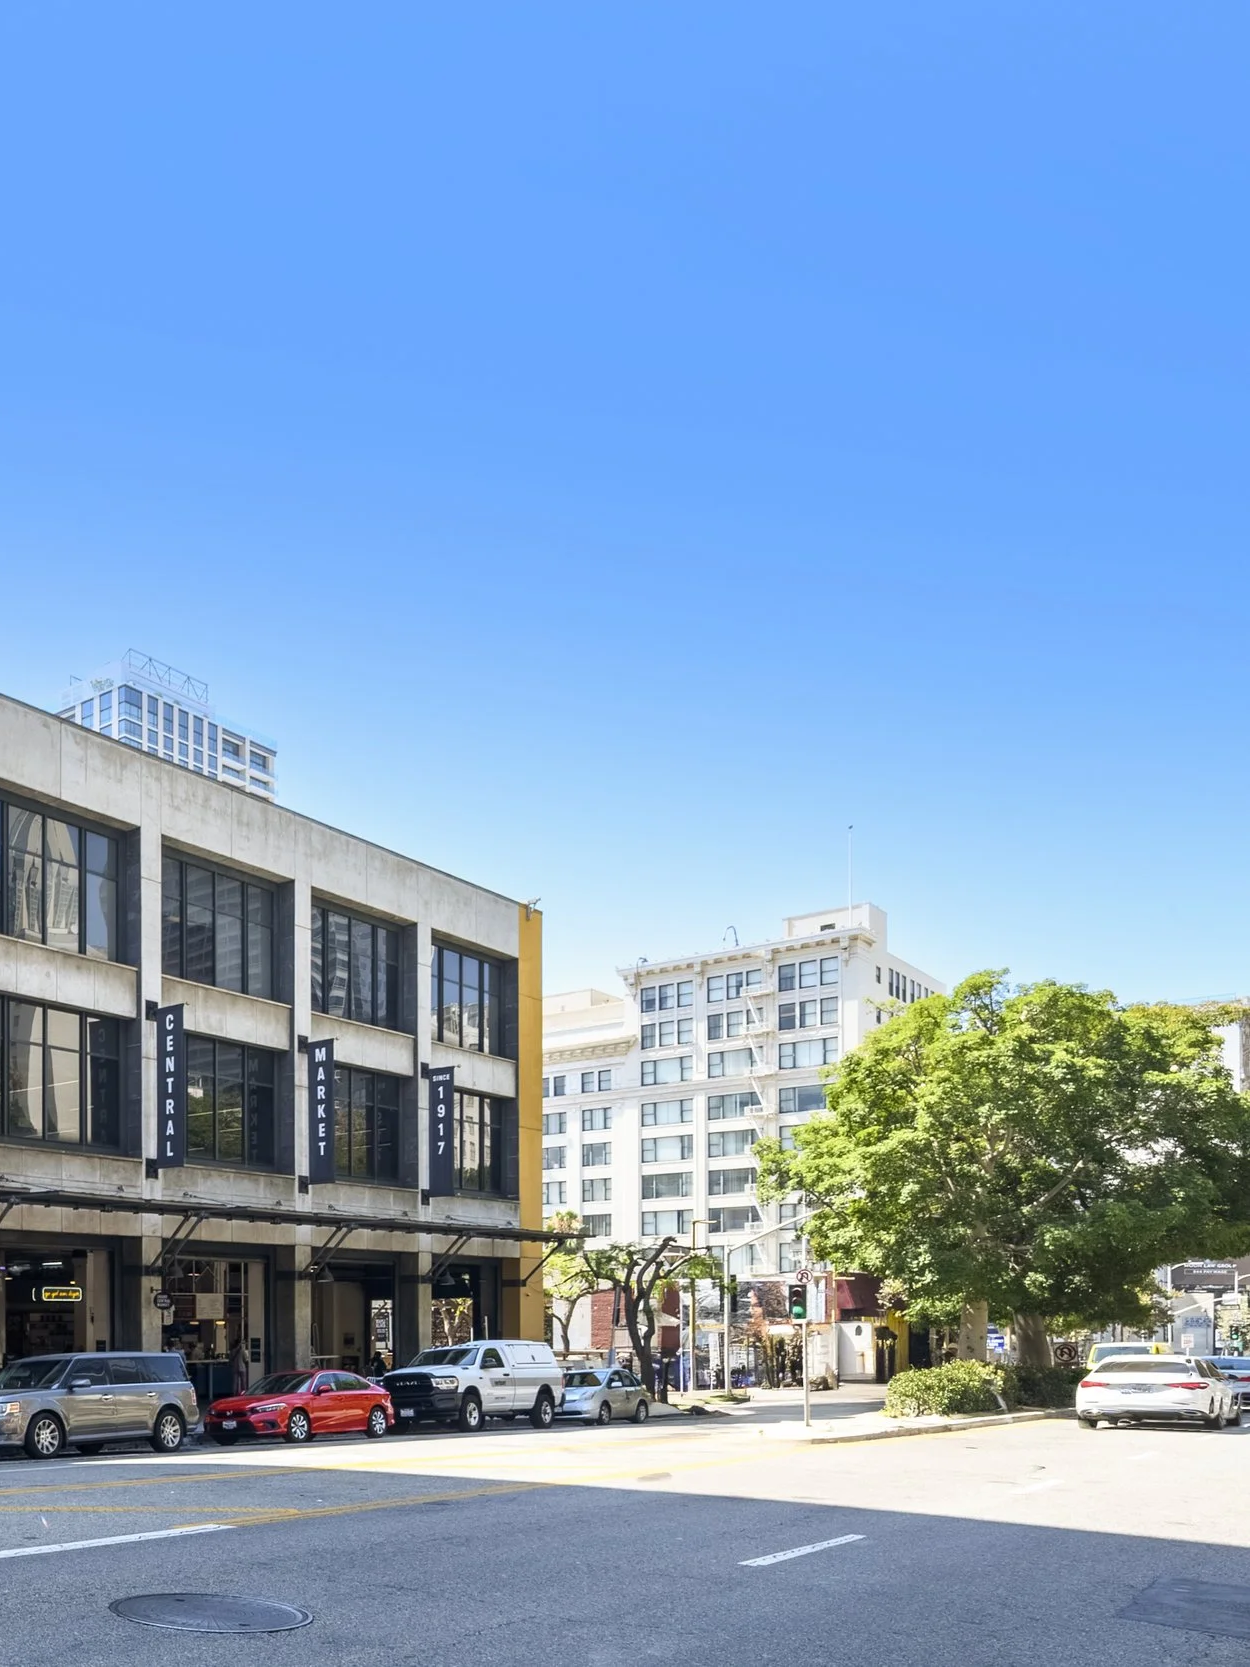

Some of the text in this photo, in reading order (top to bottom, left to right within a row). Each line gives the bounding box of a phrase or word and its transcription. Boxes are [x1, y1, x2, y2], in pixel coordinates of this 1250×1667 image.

[165, 1013, 175, 1157] CENTRAL
[314, 1047, 327, 1156] MARKET
[432, 1073, 450, 1082] SINCE
[437, 1085, 446, 1155] 1917
